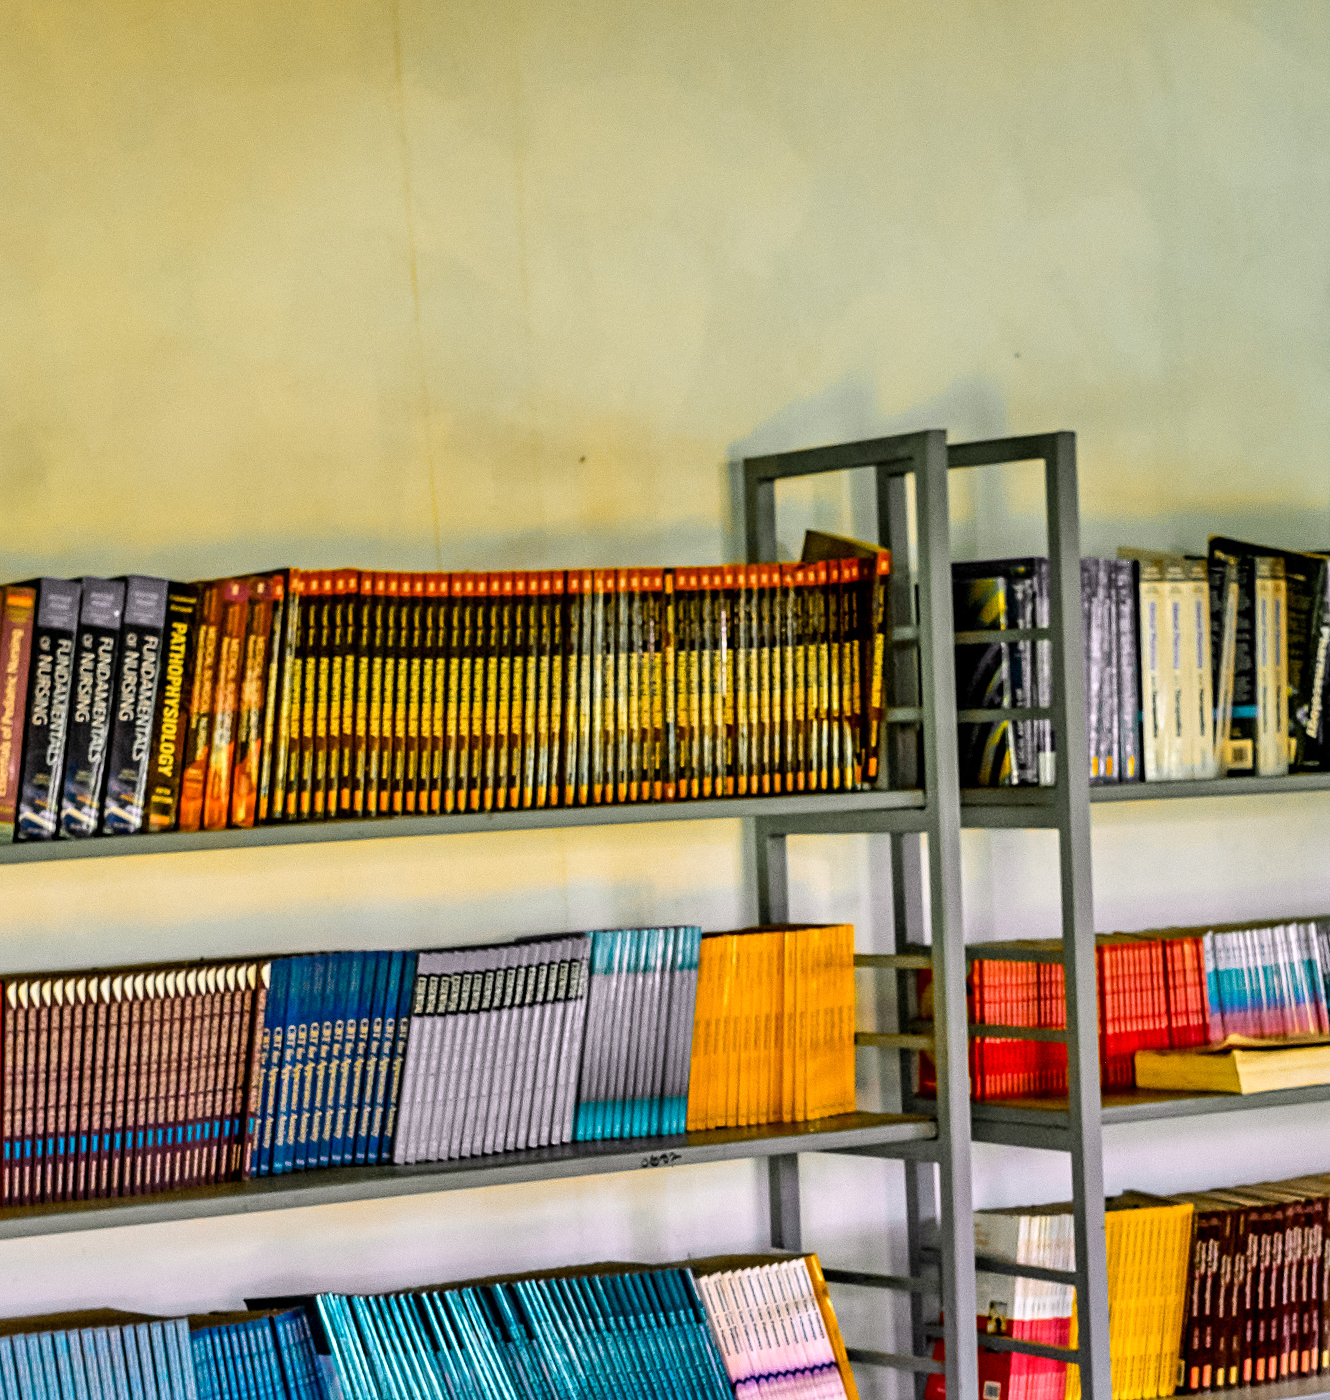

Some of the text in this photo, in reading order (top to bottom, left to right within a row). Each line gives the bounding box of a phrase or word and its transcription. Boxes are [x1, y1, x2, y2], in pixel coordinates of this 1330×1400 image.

[7, 629, 24, 673] Nursing
[119, 651, 139, 722] NURSING
[0, 675, 17, 725] Pediatric
[32, 654, 53, 726] NURSING
[47, 638, 72, 765] FUNDAMENTALS
[75, 652, 94, 722] NURSING
[88, 637, 114, 763] FUNDAMENTALS
[132, 635, 158, 761] FUNDAMENTALS
[158, 622, 187, 777] PATHOPHYSIOLOGY
[0, 726, 12, 740] of
